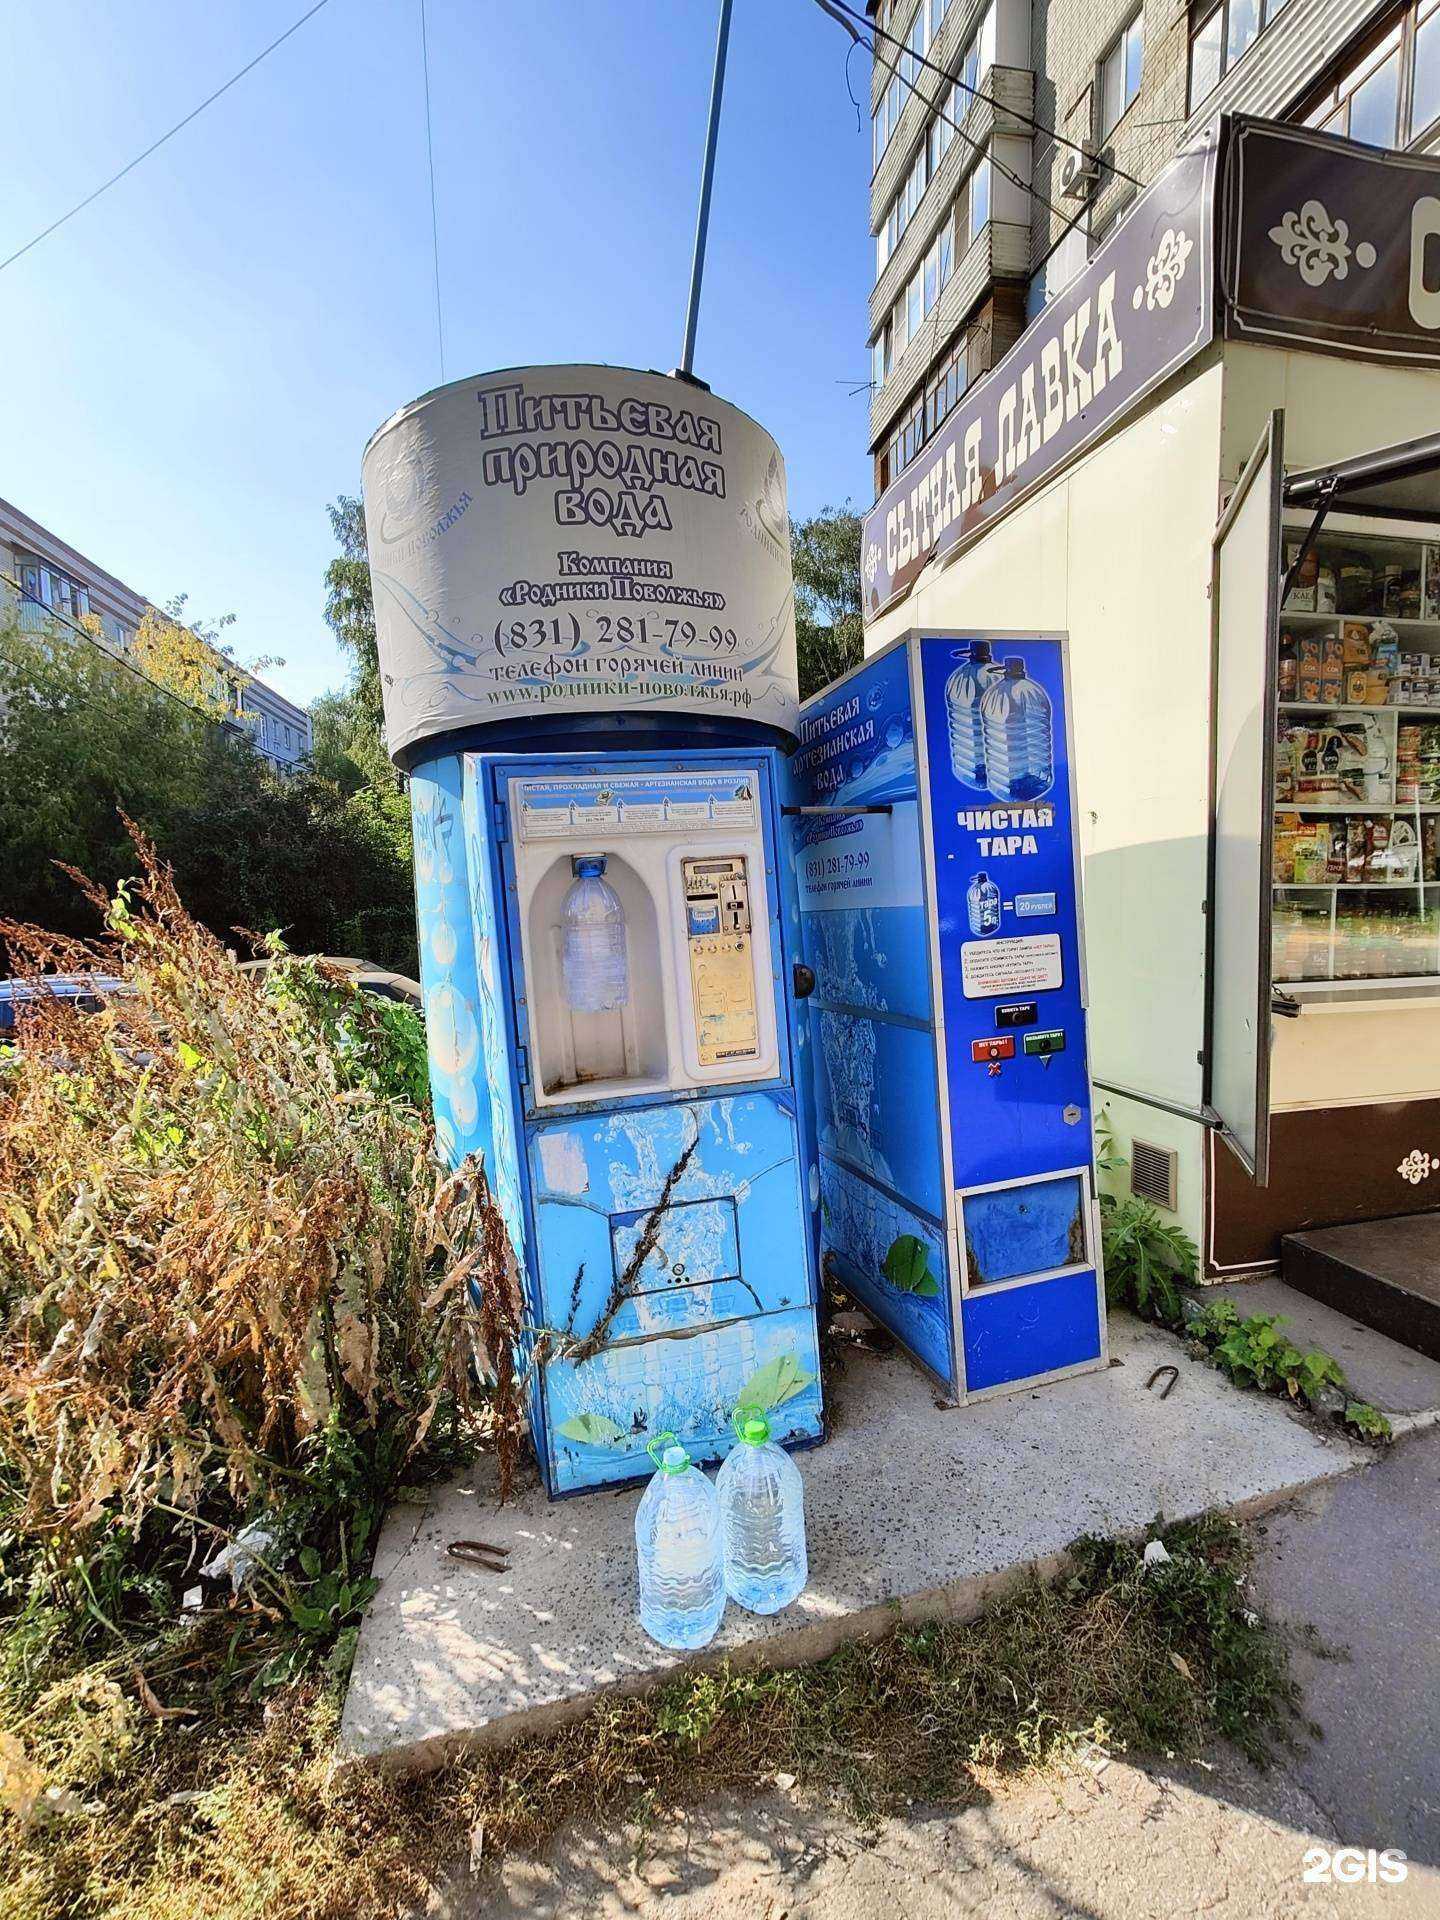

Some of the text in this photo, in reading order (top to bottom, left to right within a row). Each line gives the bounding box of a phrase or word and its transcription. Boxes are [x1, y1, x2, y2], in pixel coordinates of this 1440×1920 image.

[886, 270, 1122, 576] СЫТНАЯ ЛАВКА
[483, 439, 726, 499] природная
[555, 487, 673, 538] вода
[558, 551, 673, 579] Компания
[499, 576, 726, 611] «Родники Поволжья»
[494, 612, 737, 658] (831) 281-79-99
[489, 655, 743, 682] телефон горячей линии
[487, 680, 752, 708] www.родники-поволжья.рф
[645, 779, 697, 787] АРТЕЗИАНСКАЯ
[957, 807, 1053, 831] ЧИСТАЯ
[976, 835, 1038, 857] ТАРА
[805, 851, 870, 879] (831) 281-79-99
[1019, 901, 1030, 911] 20
